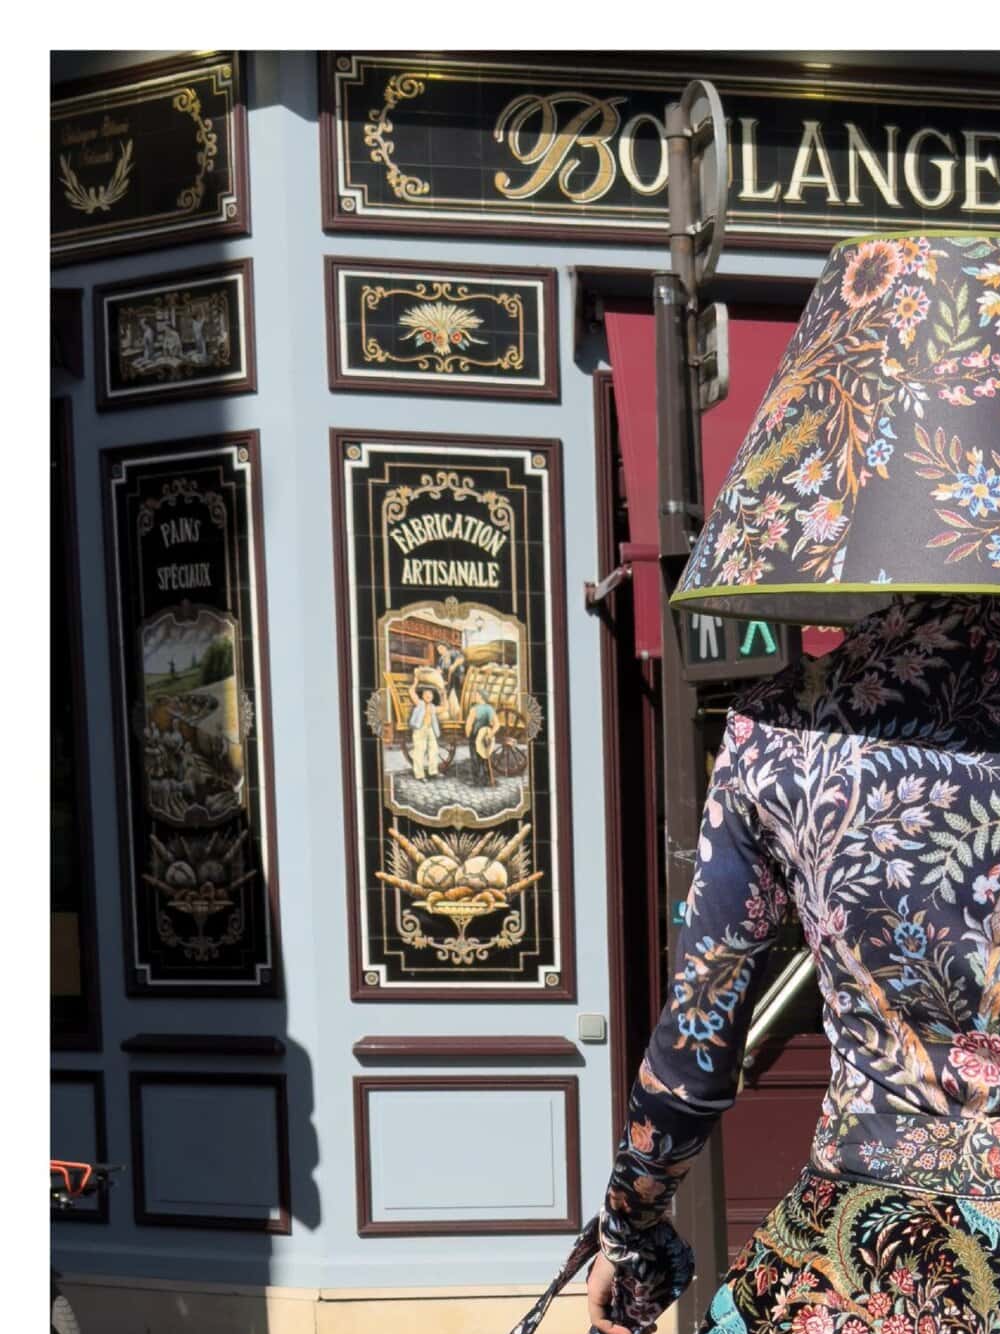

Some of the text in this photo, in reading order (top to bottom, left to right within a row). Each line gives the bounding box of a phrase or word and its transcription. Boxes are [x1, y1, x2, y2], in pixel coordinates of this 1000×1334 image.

[160, 517, 202, 550] PAINS
[390, 513, 507, 557] FABRICATION
[402, 558, 499, 588] ARTISANALE
